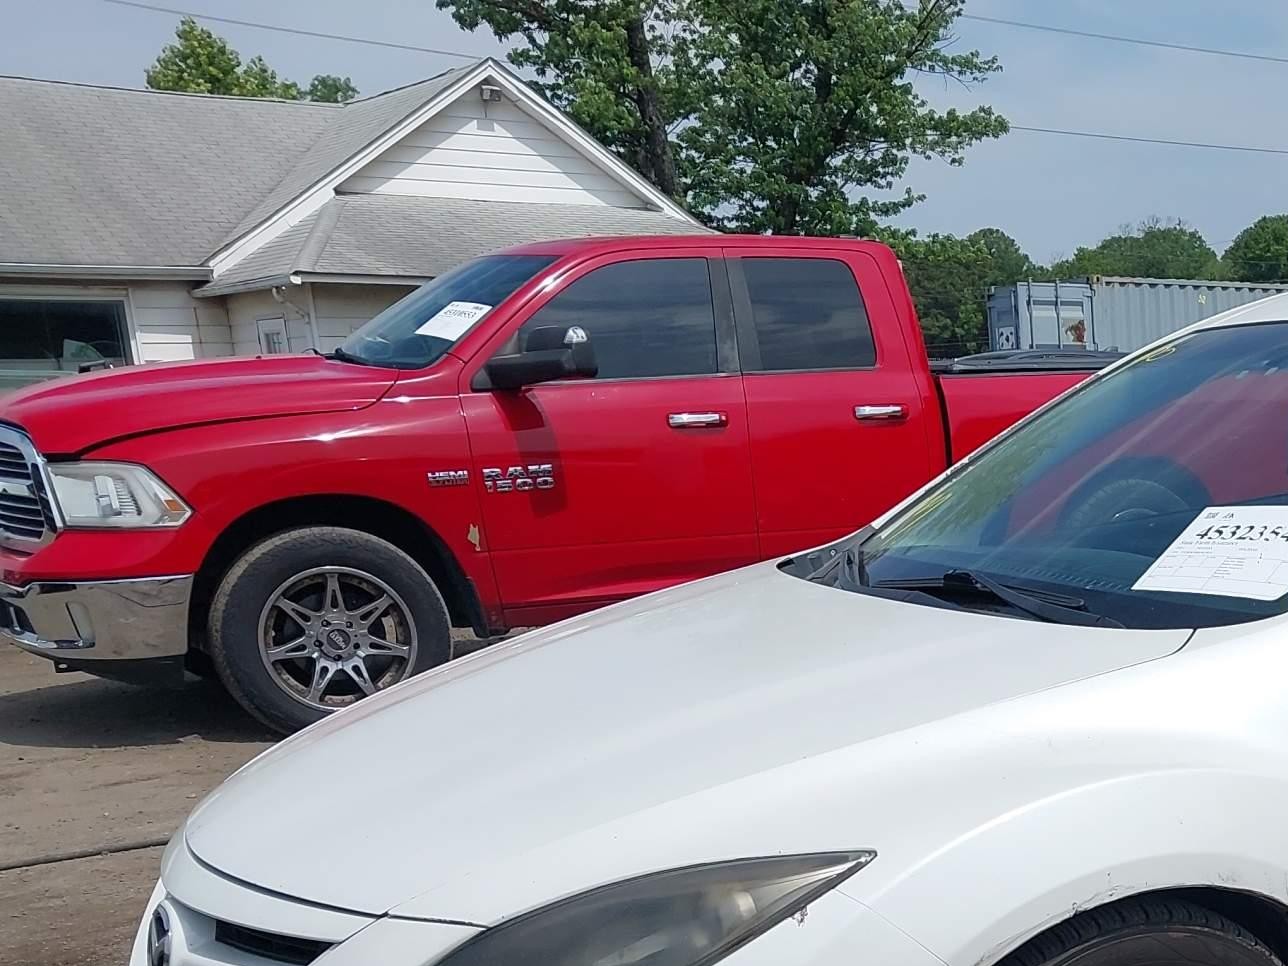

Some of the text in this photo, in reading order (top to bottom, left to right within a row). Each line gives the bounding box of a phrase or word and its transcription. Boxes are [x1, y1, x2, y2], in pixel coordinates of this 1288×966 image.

[427, 470, 469, 481] HEMI
[482, 463, 553, 481] RAM
[484, 477, 555, 493] 1500
